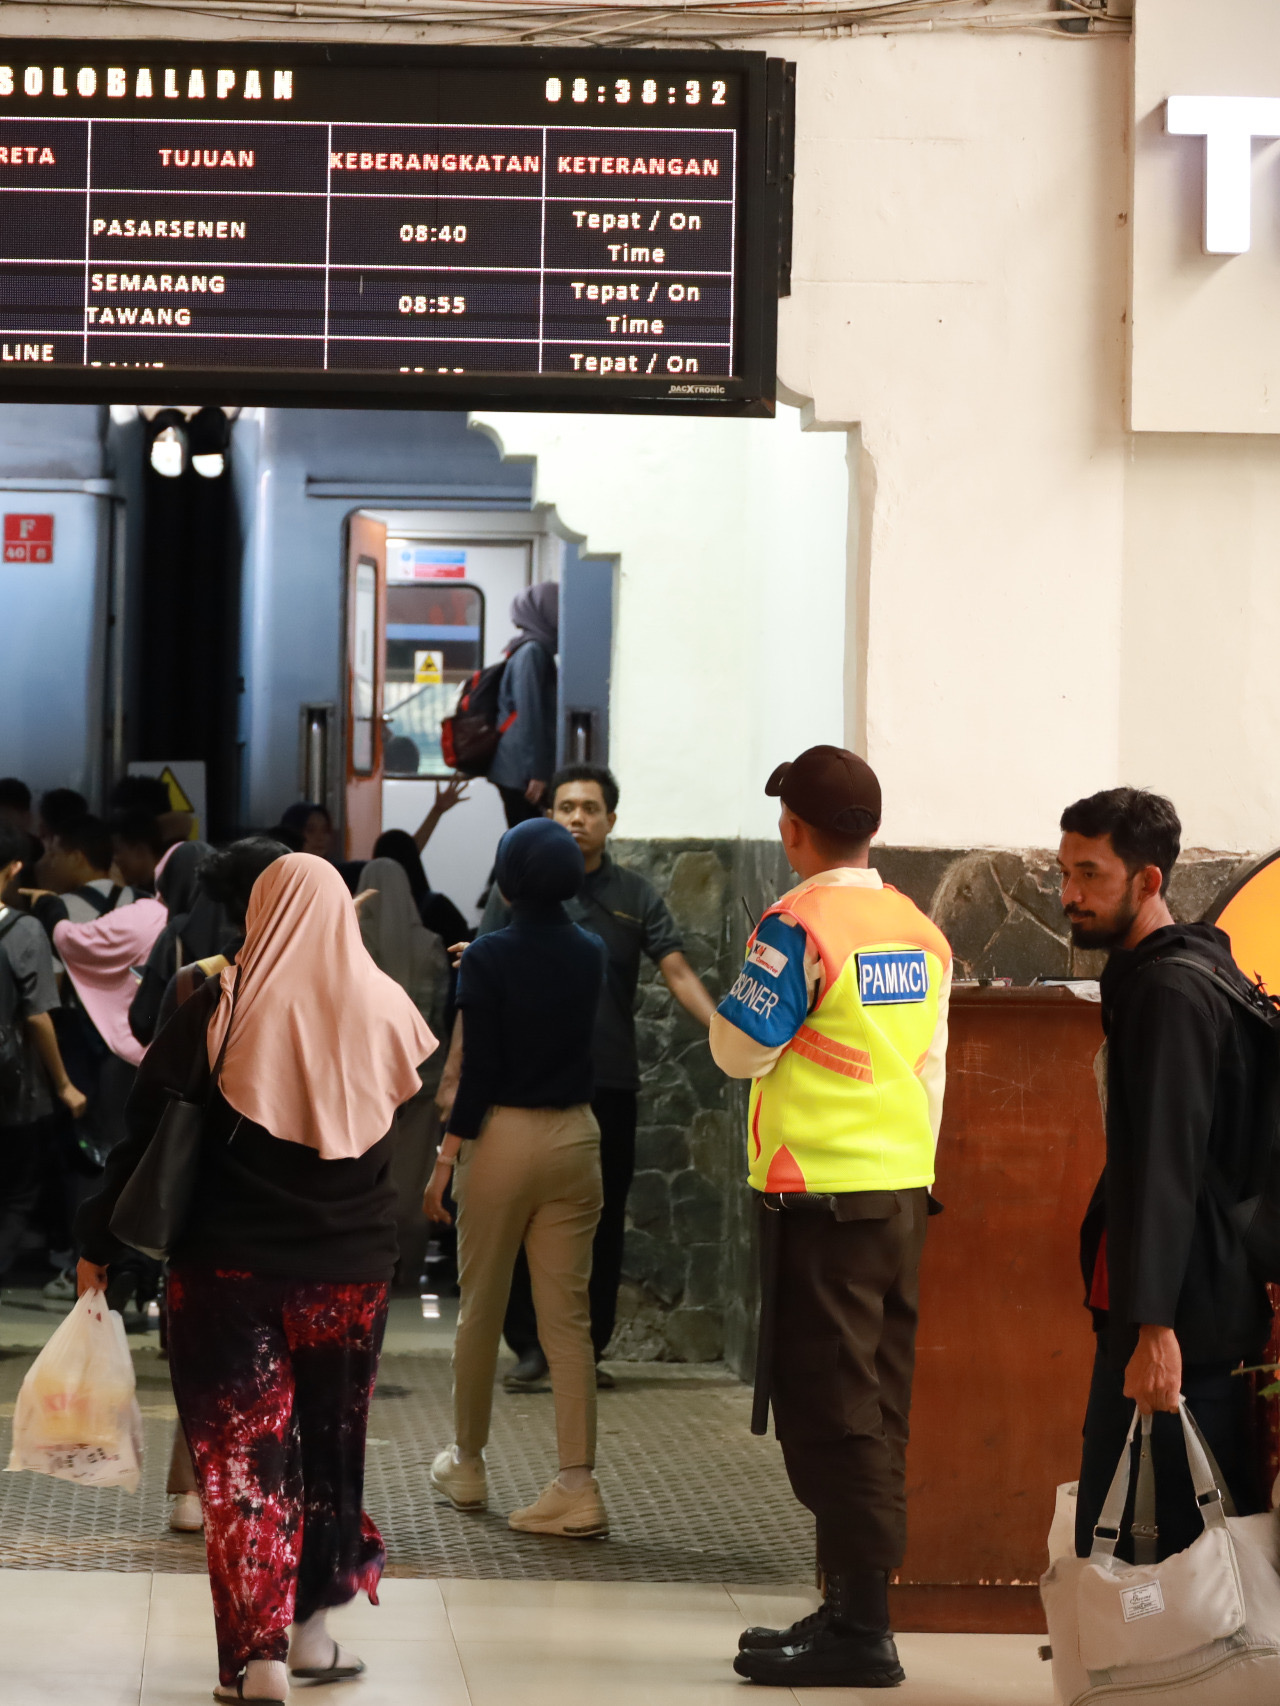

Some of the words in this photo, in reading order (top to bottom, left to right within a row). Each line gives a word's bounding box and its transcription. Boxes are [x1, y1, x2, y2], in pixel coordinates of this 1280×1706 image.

[545, 77, 726, 106] 08:38:32
[158, 148, 255, 168] TUJUAN
[330, 152, 541, 173] KEBERANGKATAN
[556, 155, 719, 177] KETERANGAN
[92, 218, 246, 239] PASARSENEN
[572, 210, 642, 234] Tepat
[648, 210, 661, 232] /
[669, 212, 702, 231] On
[399, 224, 467, 244] 08:40
[607, 242, 666, 264] Time
[91, 273, 226, 294] SEMARANG
[570, 282, 640, 305] Tepat
[646, 281, 660, 304] /
[667, 283, 701, 302] On
[398, 295, 467, 315] 08:55
[87, 306, 191, 326] TAWANG
[605, 313, 665, 335] Time
[2, 343, 54, 363] LINE
[569, 353, 639, 376] Tepat
[645, 352, 659, 375] /
[666, 355, 699, 374] On
[755, 956, 779, 974] Commuter
[861, 961, 927, 996] PAMKCI
